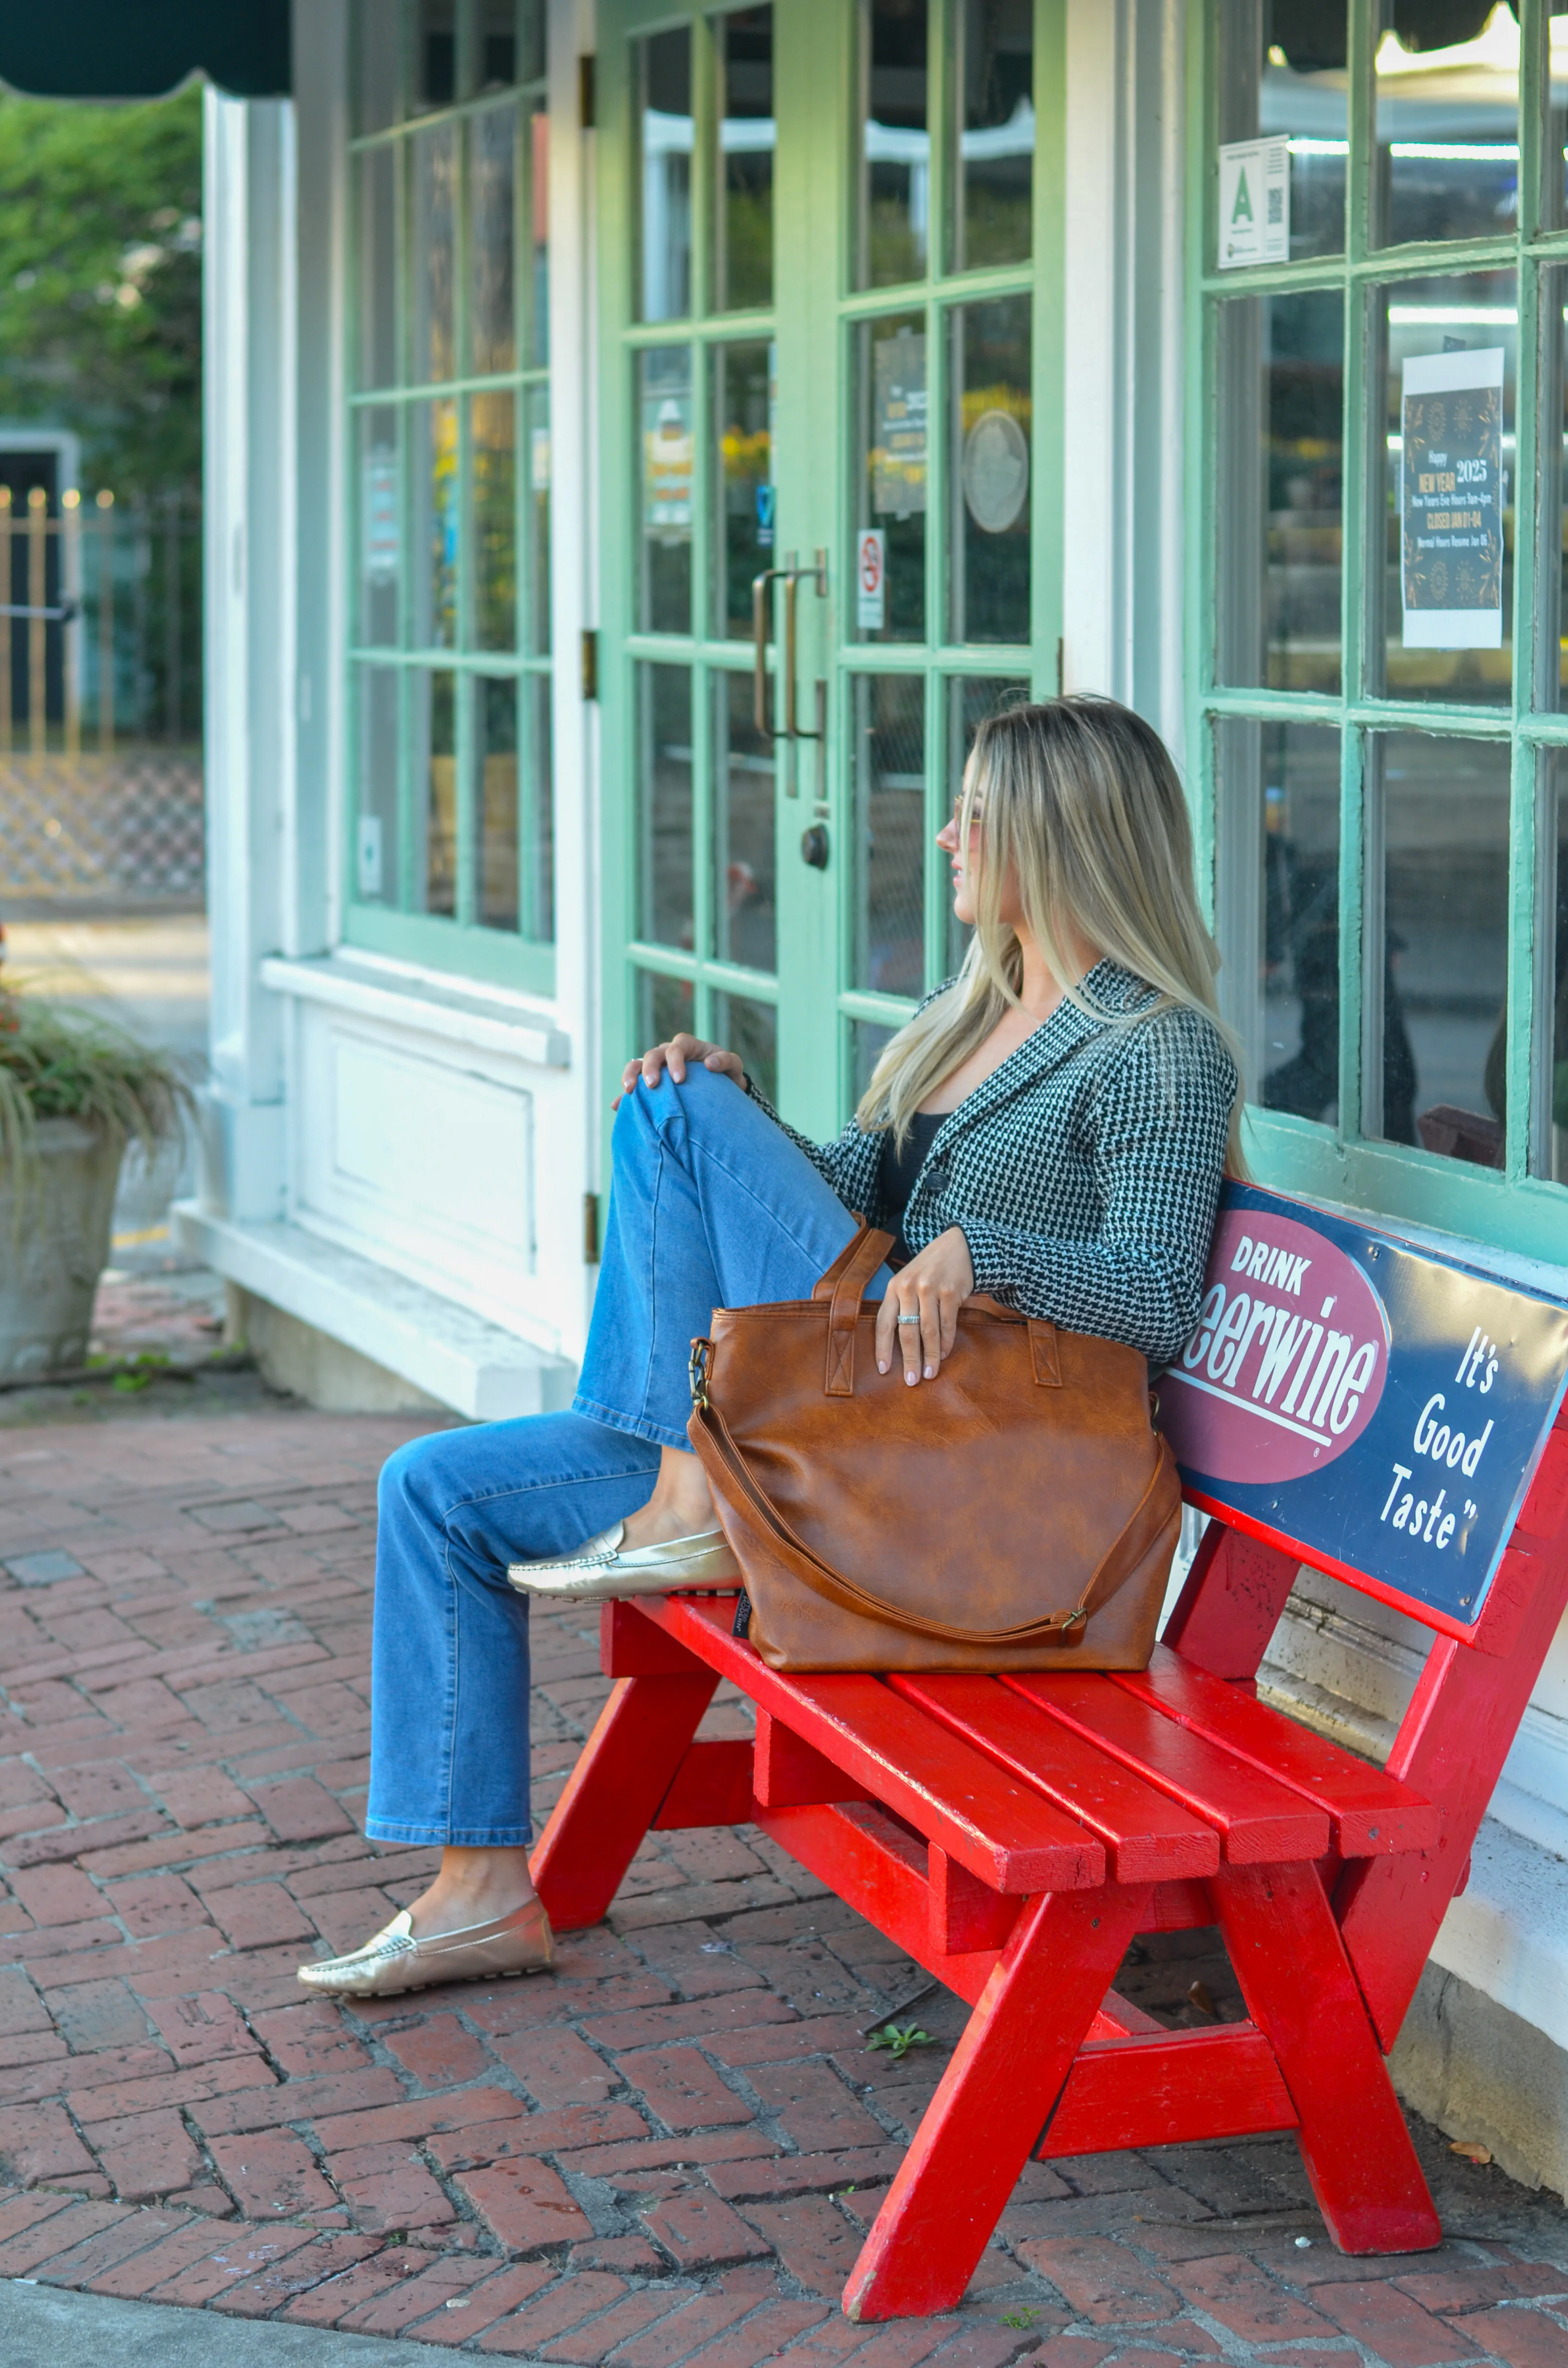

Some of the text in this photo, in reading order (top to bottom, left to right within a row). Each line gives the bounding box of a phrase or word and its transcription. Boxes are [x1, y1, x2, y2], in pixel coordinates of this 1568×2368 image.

[1231, 164, 1254, 224] A
[1419, 471, 1456, 493] NEW YEAR
[1456, 459, 1487, 483] 2025
[1427, 512, 1450, 530] CLOSED
[1451, 511, 1462, 528] JAN
[1231, 1235, 1312, 1296] DRINK
[1183, 1283, 1378, 1434] eerwine
[1454, 1326, 1498, 1394] It's
[1413, 1393, 1494, 1478] Good
[1380, 1463, 1477, 1550] Taste"
